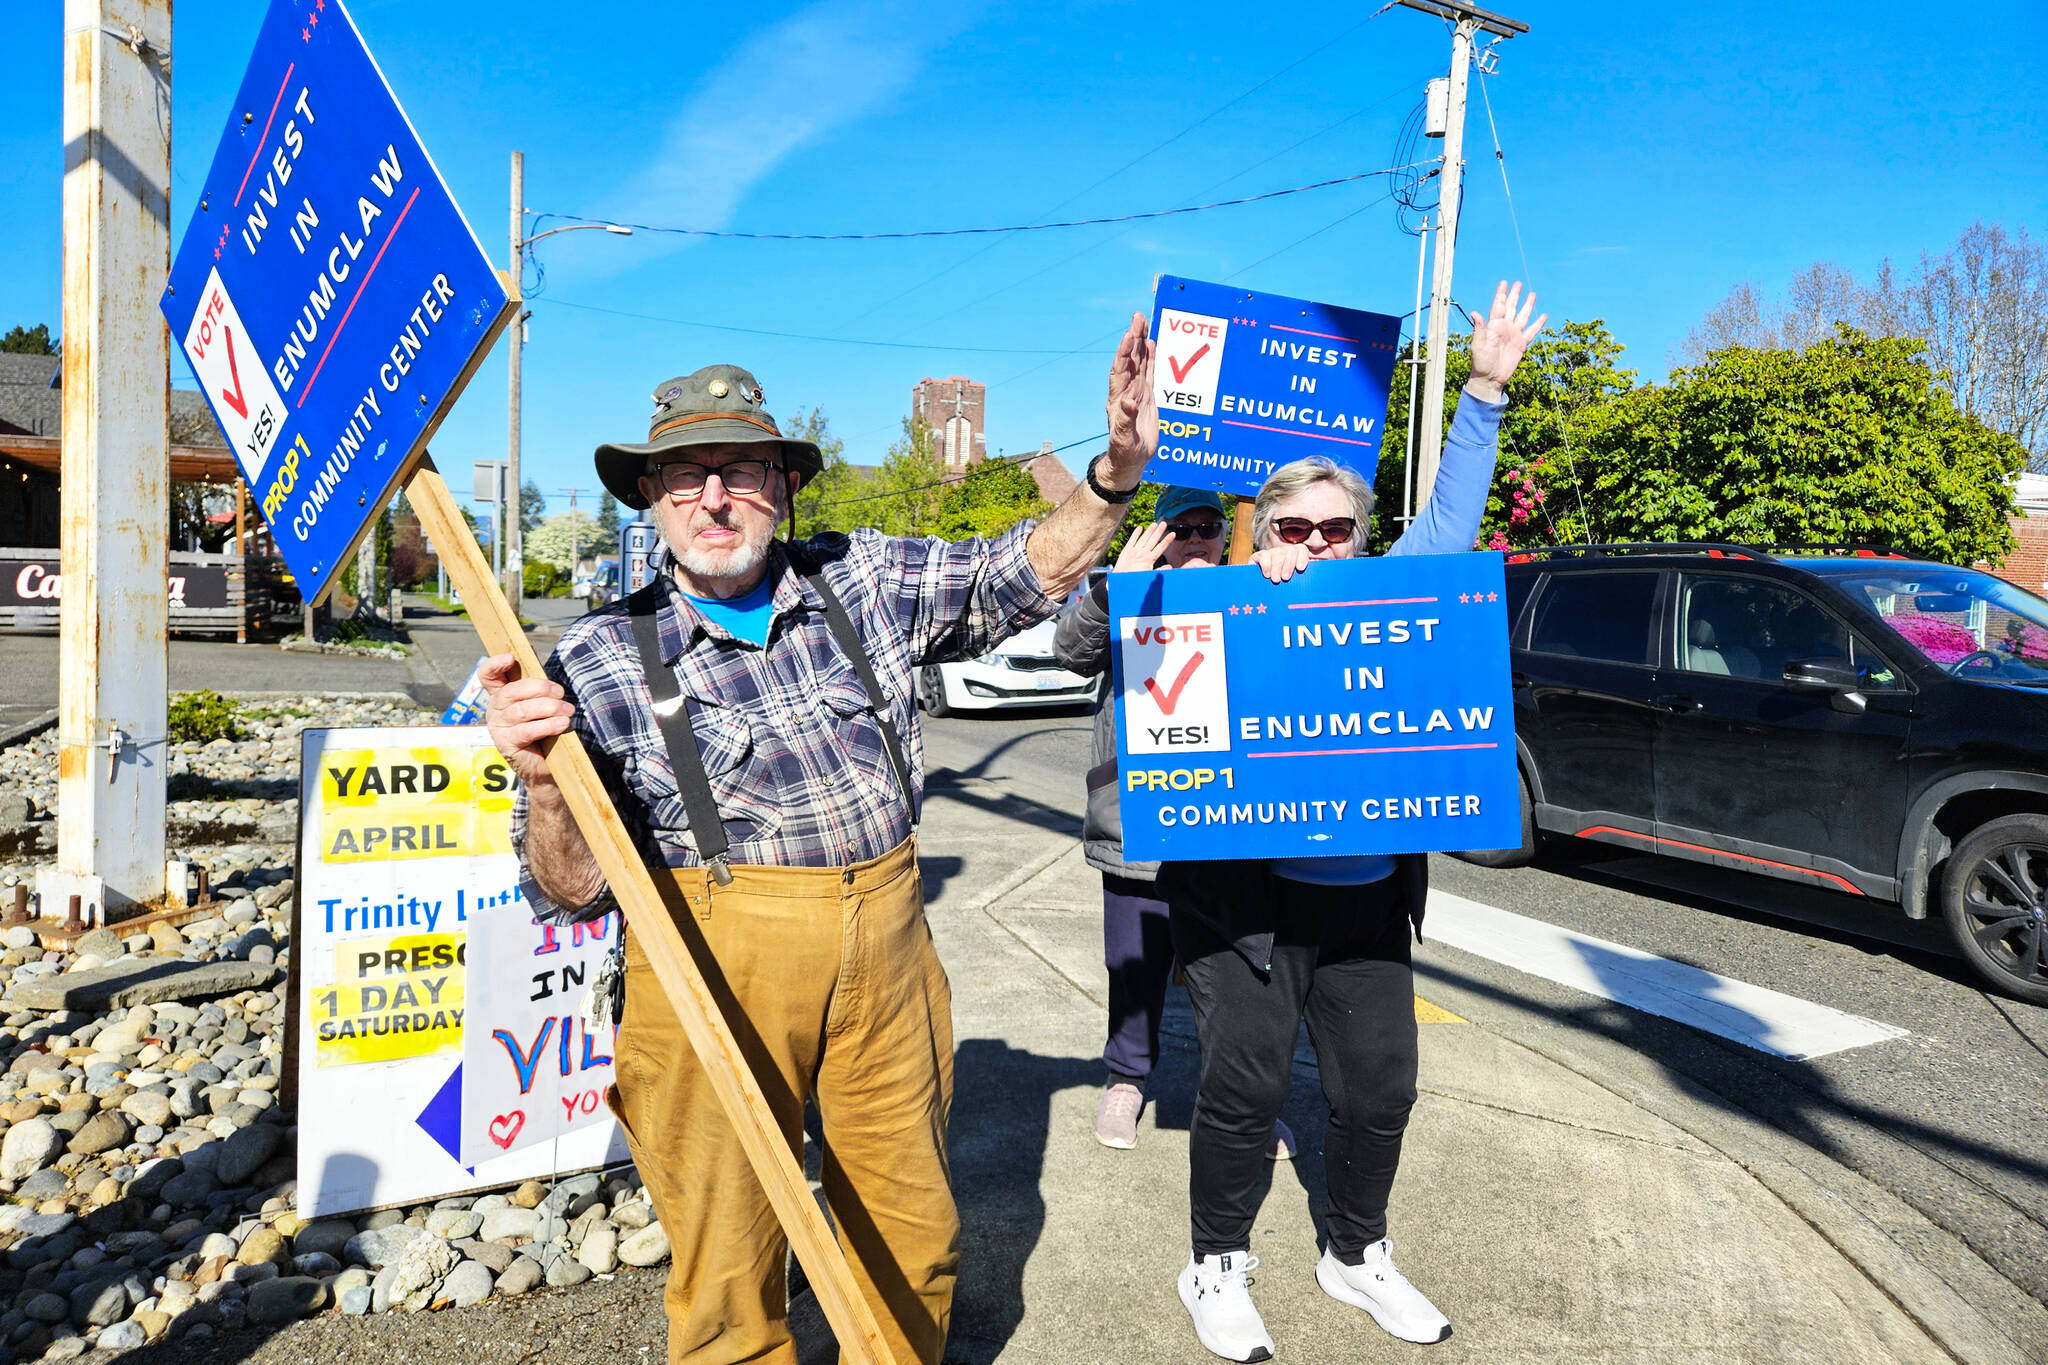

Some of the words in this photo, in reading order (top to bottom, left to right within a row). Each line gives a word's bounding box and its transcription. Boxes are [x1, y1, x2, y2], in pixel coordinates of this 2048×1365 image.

[240, 86, 317, 255] INVEST
[289, 197, 320, 254] IN
[273, 145, 403, 392] ENUMCLAW
[192, 288, 225, 360] VOTE
[1168, 317, 1220, 339] VOTE
[1260, 338, 1357, 369] INVEST
[1163, 389, 1202, 408] YES!
[1290, 375, 1317, 394] IN
[293, 388, 382, 541] COMMUNITY
[380, 272, 455, 393] CENTER
[1220, 394, 1375, 434] ENUMCLAW
[247, 402, 276, 468] YES!
[1158, 419, 1200, 439] ROP
[1157, 445, 1276, 476] COMMUNITY
[1133, 624, 1212, 647] VOTE
[1282, 617, 1440, 648] INVEST
[1344, 666, 1384, 690] IN
[1147, 726, 1209, 746] YES!
[1240, 706, 1494, 741] ENUMCLAW
[328, 764, 450, 796] YARD
[1158, 800, 1347, 827] COMMUNITY
[1361, 795, 1481, 821] CENTER
[330, 824, 457, 854] APRIL
[318, 894, 442, 933] Trinity
[319, 991, 338, 1017] 1
[361, 976, 448, 1013] DAY
[530, 960, 584, 1001] IN
[318, 1008, 464, 1042] SATURDAY
[492, 1015, 618, 1094] VIL
[561, 1089, 606, 1122] YO
